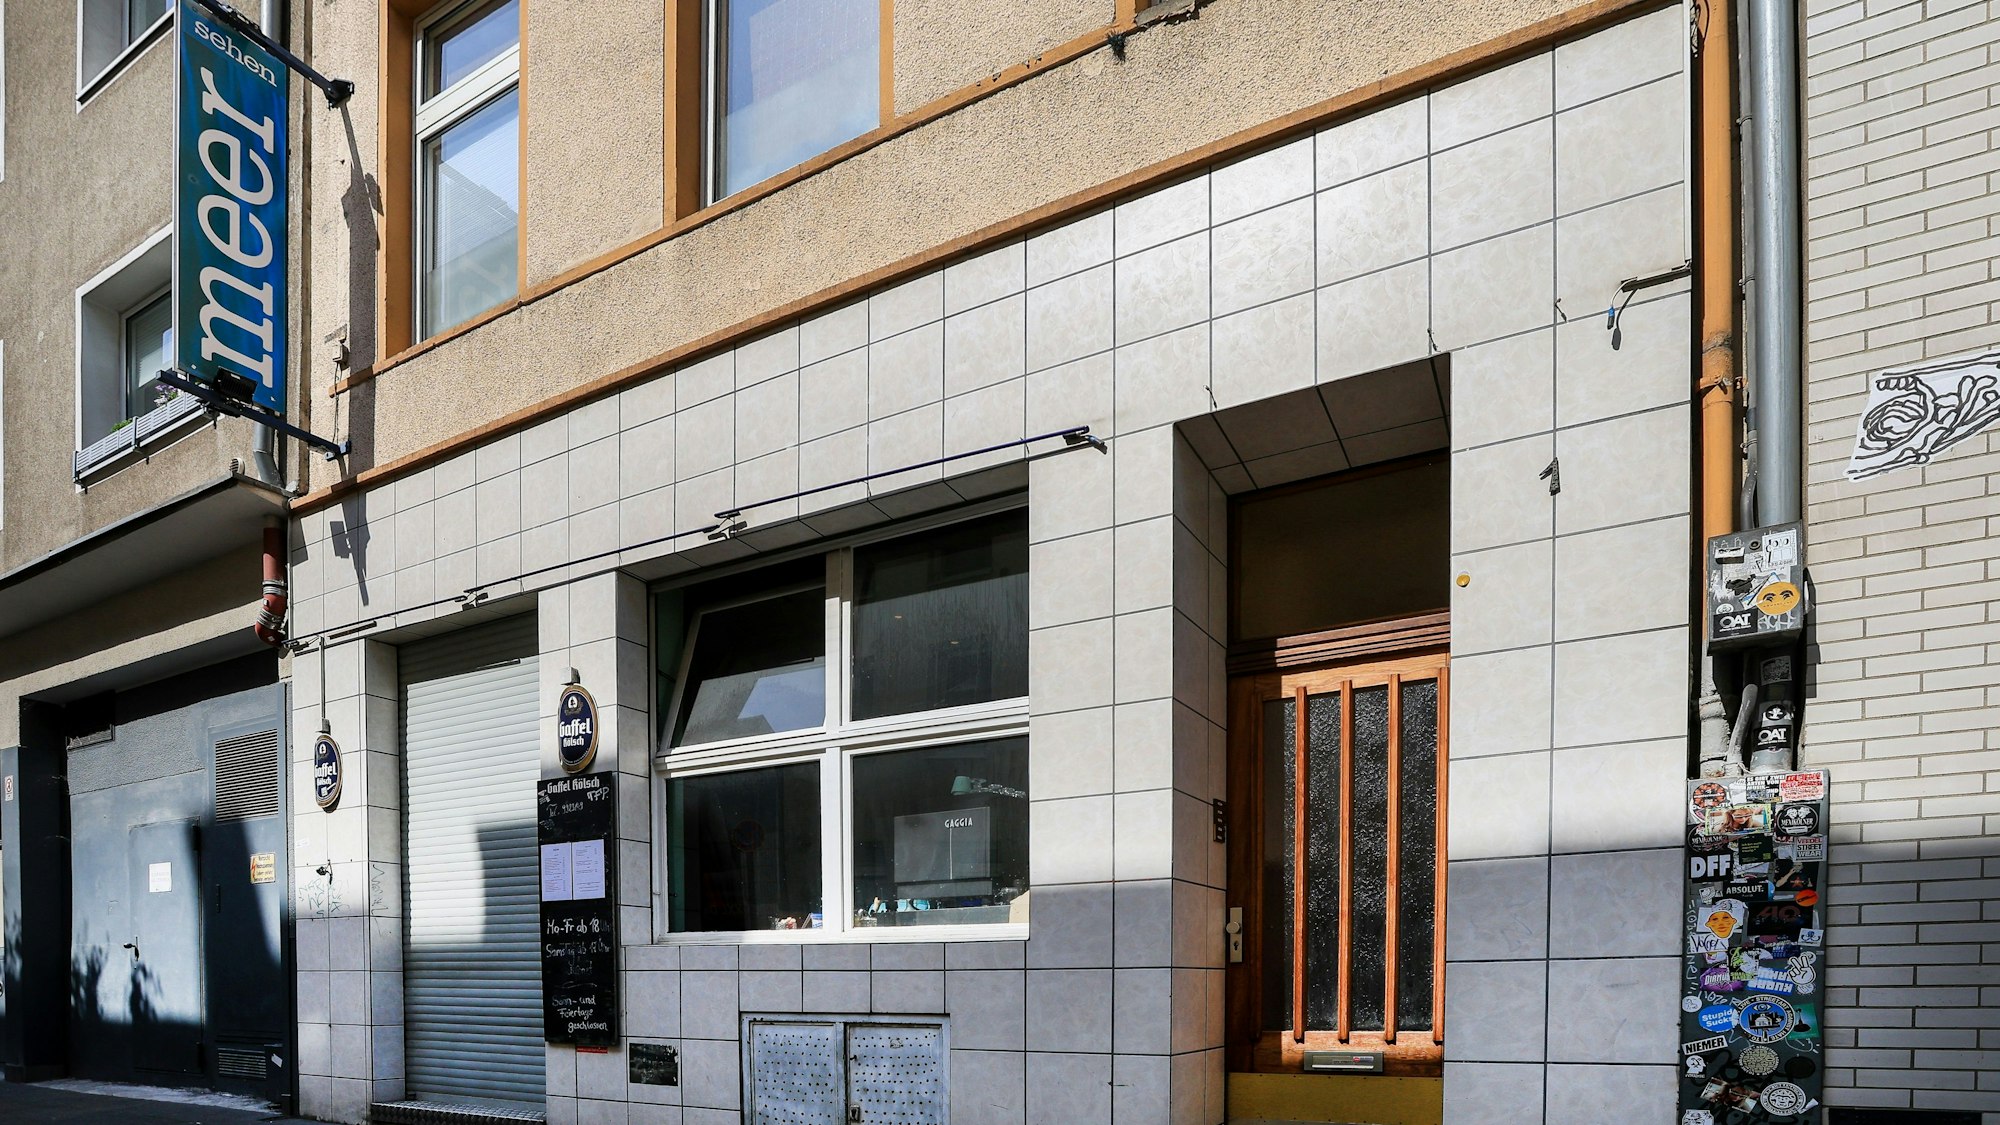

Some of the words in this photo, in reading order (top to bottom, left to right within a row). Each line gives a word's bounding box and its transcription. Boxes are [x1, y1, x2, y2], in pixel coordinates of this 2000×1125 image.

[194, 20, 277, 88] sehen
[198, 66, 274, 389] meer
[1719, 613, 1751, 628] OAT
[560, 718, 592, 738] Gaffel
[1758, 728, 1787, 742] OAT
[563, 736, 584, 748] Kölsch
[547, 780, 571, 794] Gaffel
[572, 776, 600, 791] Kölsch
[944, 817, 973, 829] GAGGIA
[1797, 850, 1822, 858] WEAR
[1690, 854, 1731, 879] DFF
[576, 918, 588, 934] ab
[589, 917, 600, 933] 18
[579, 994, 597, 1006] und
[557, 1006, 594, 1020] Feiertage
[1702, 1008, 1733, 1022] Stupid
[567, 1020, 609, 1033] geschlossen
